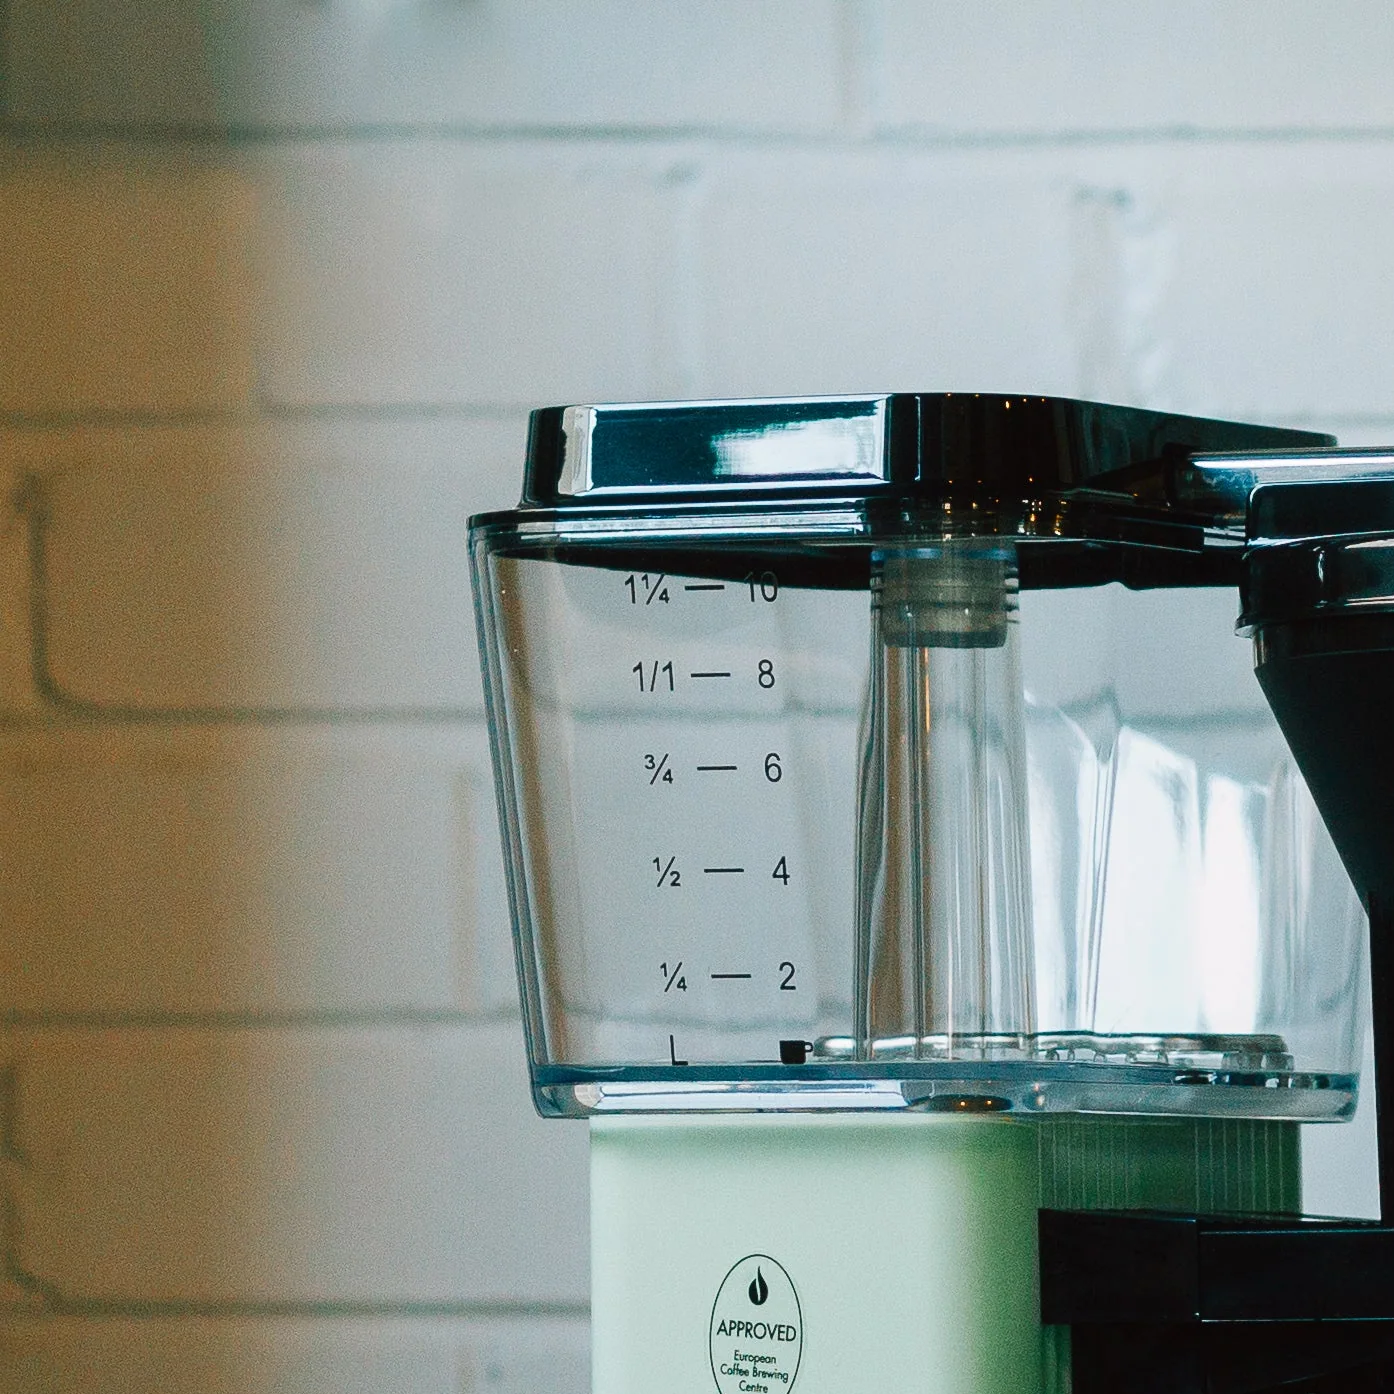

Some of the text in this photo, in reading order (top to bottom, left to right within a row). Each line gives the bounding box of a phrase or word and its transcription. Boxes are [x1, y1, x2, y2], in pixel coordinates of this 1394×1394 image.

[744, 571, 778, 602] 10
[632, 659, 775, 692] 1/1 8
[764, 752, 782, 783] 6
[772, 856, 790, 886] 4
[779, 962, 796, 990] 2
[716, 1319, 797, 1342] APPROVED
[734, 1350, 777, 1366] European
[720, 1363, 789, 1384] Coffee Brewing
[738, 1380, 769, 1393] Centre
